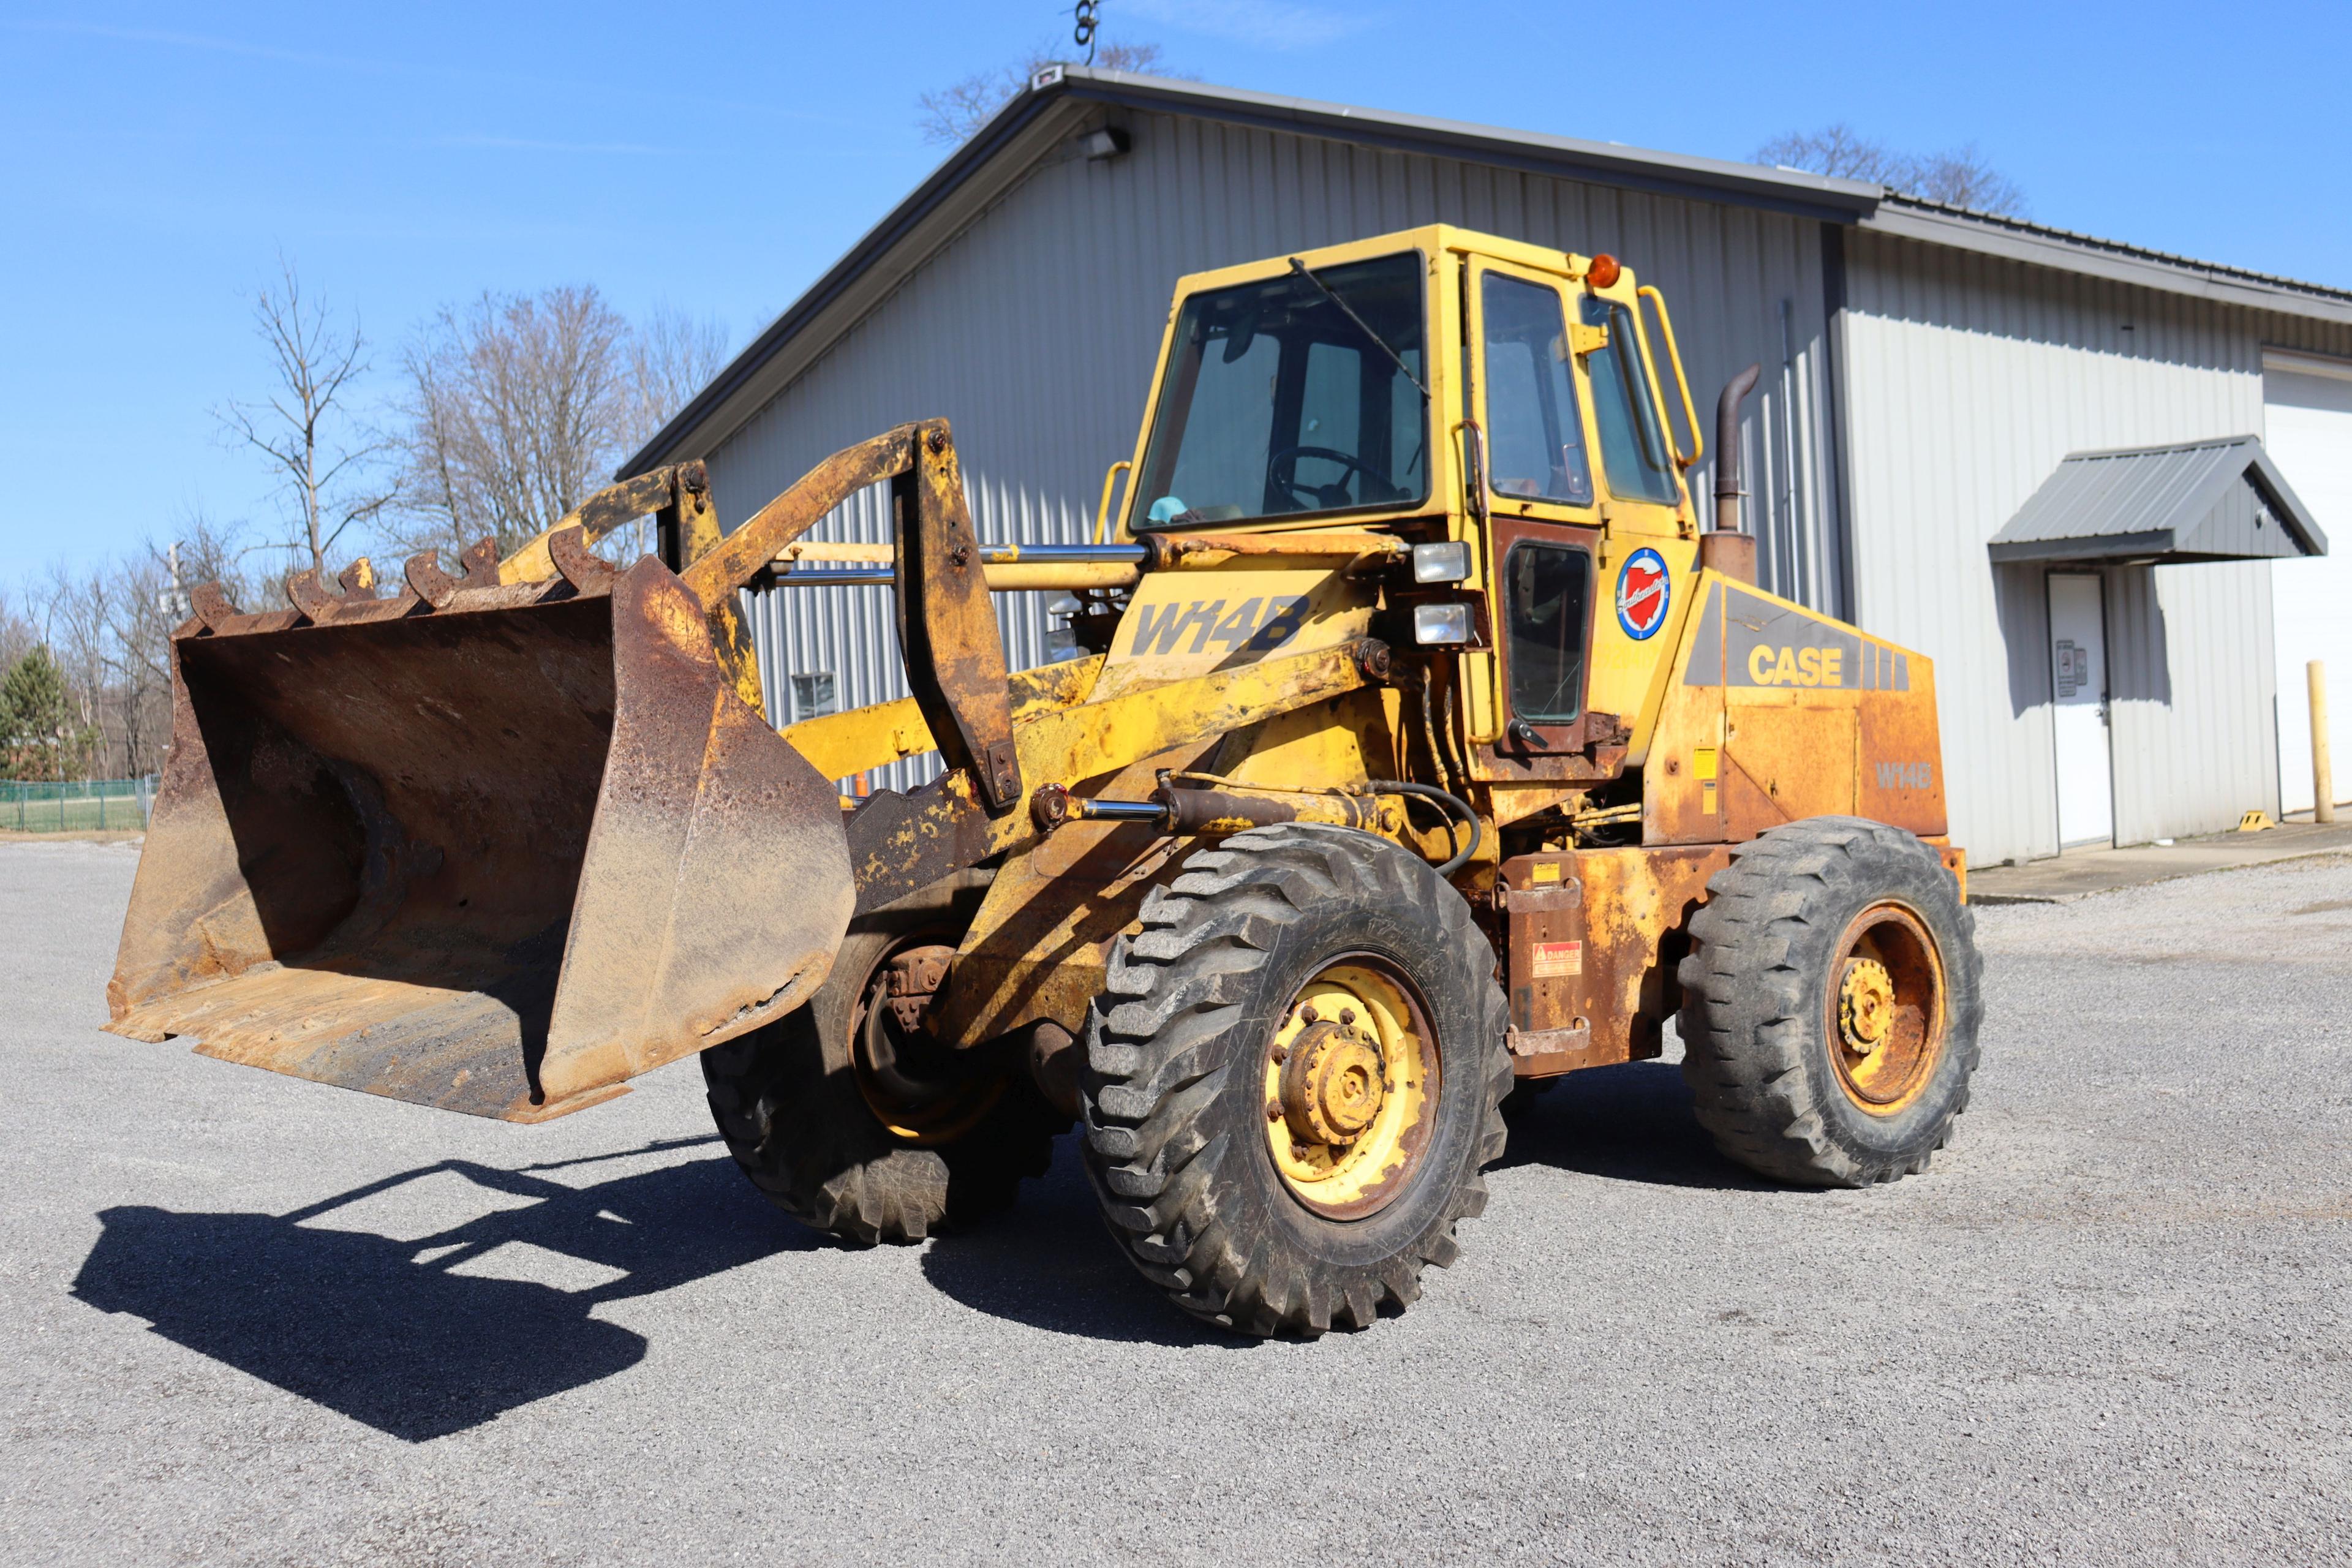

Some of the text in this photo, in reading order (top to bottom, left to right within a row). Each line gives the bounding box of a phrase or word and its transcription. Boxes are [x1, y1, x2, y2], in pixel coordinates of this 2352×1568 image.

[1130, 595, 1310, 656] W14B
[1748, 644, 1841, 686] CASE
[1876, 762, 1931, 789] W14B
[1547, 949, 1580, 960] DANGER
